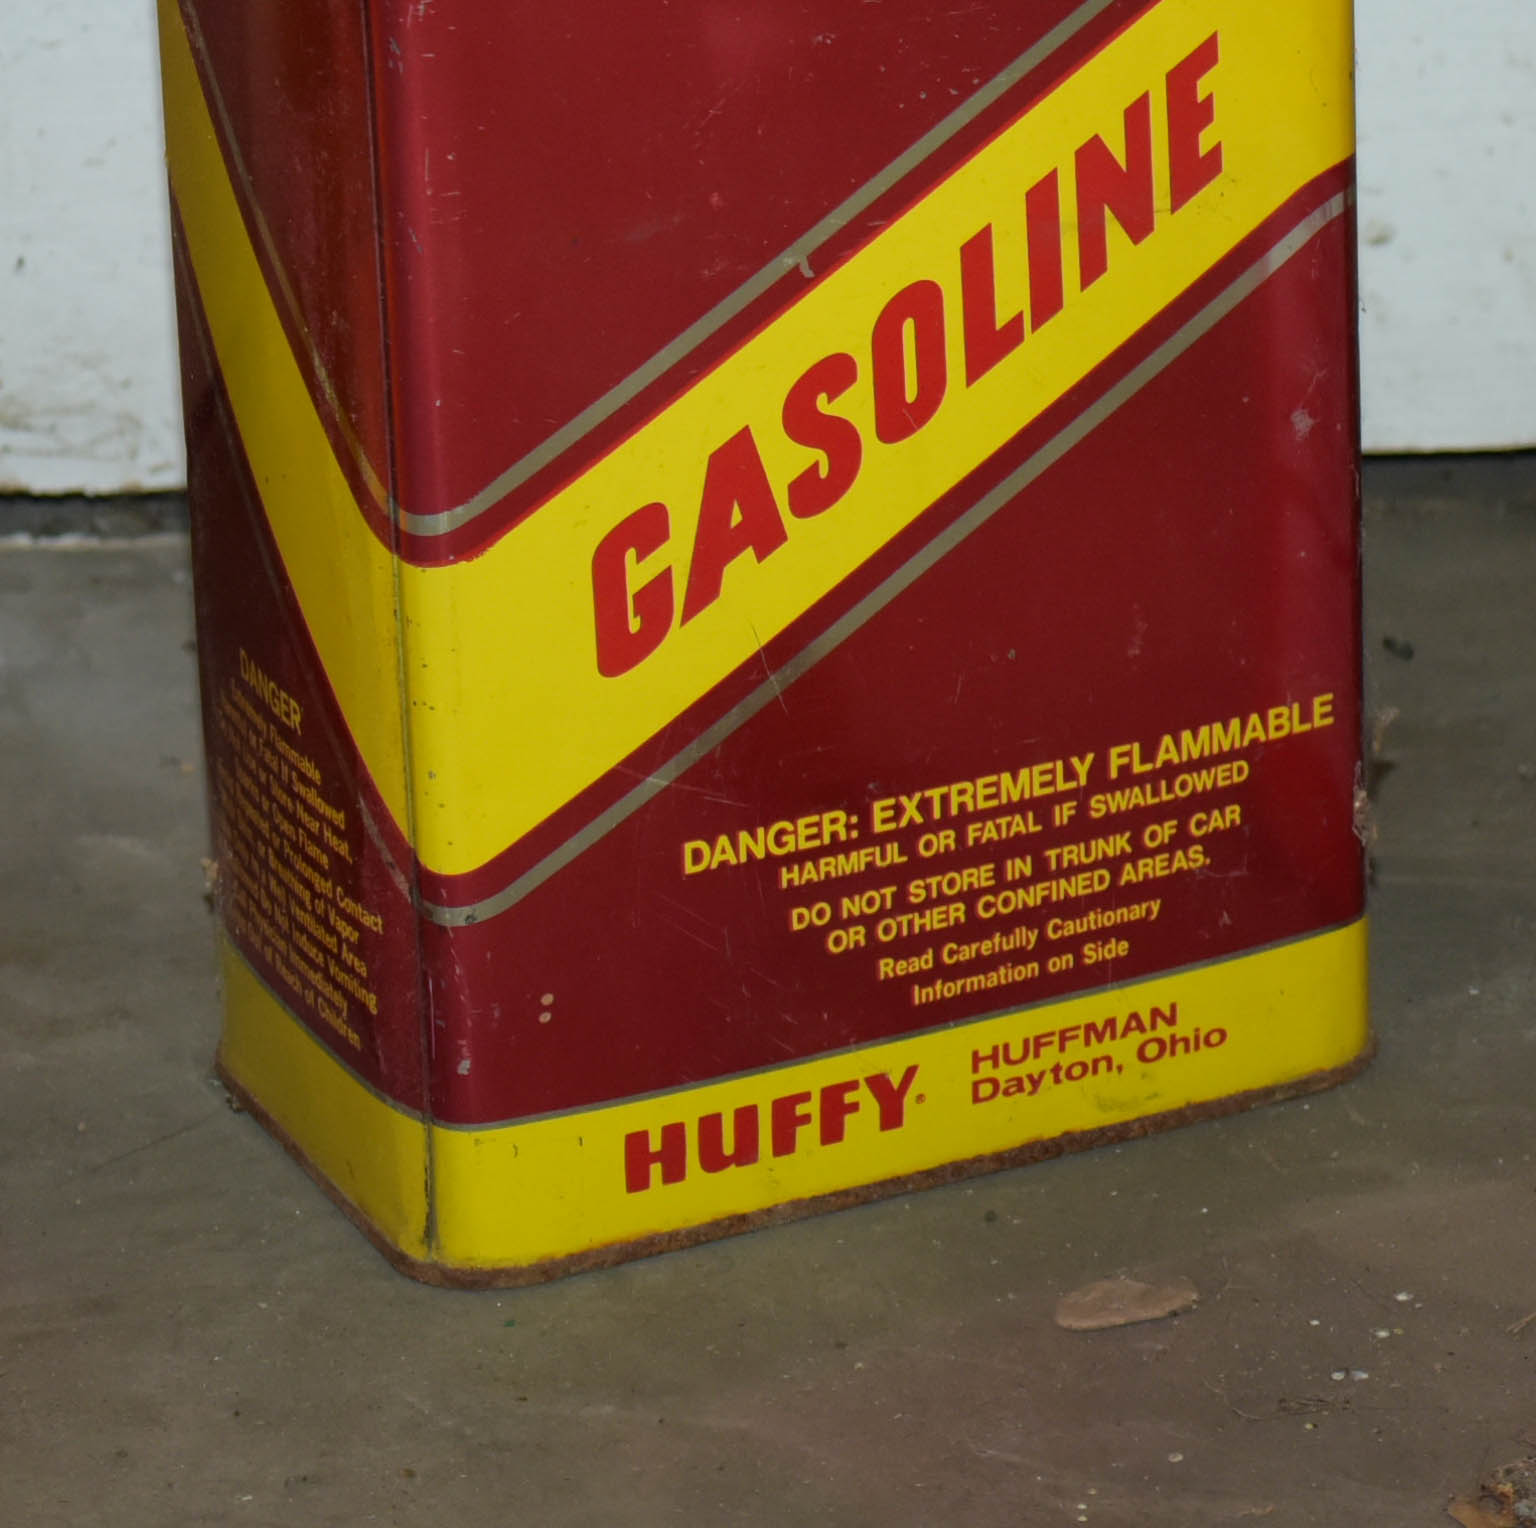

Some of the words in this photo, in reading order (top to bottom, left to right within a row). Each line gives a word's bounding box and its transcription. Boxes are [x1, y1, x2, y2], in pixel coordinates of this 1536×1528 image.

[591, 30, 1223, 678] GASOLINE
[240, 647, 301, 736] DANGER
[682, 807, 859, 875] DANGER:
[873, 753, 1095, 834] EXTREMELY
[1108, 693, 1335, 780] FLAMMABLE
[780, 844, 908, 889] HARMFUL
[919, 829, 957, 859] OR
[967, 810, 1043, 848] FATAL
[1054, 800, 1078, 828] IF
[1089, 759, 1250, 819] SWALLOWED
[336, 885, 384, 936] Contact
[791, 900, 832, 932] DO
[841, 886, 899, 919] NOT
[908, 863, 997, 904] STORE
[1006, 853, 1033, 882] IN
[1044, 832, 1132, 875] TRUNK
[1143, 820, 1178, 850] OF
[1190, 803, 1243, 838] CAR
[826, 925, 867, 956] OR
[876, 903, 966, 944] OTHER
[976, 869, 1111, 920] CONFINED
[1120, 844, 1212, 886] AREAS.
[327, 903, 360, 945] Vapor
[878, 950, 934, 981] Read
[941, 926, 1038, 968] Carefully
[1046, 898, 1162, 943] Cautionary
[913, 958, 1041, 1006] Information
[1048, 952, 1075, 973] on
[1082, 937, 1131, 966] Side
[970, 1003, 1180, 1075] HUFFMAN
[970, 1053, 1124, 1105] Dayton,
[1137, 1023, 1228, 1066] Ohio
[624, 1064, 920, 1194] HUFFY
